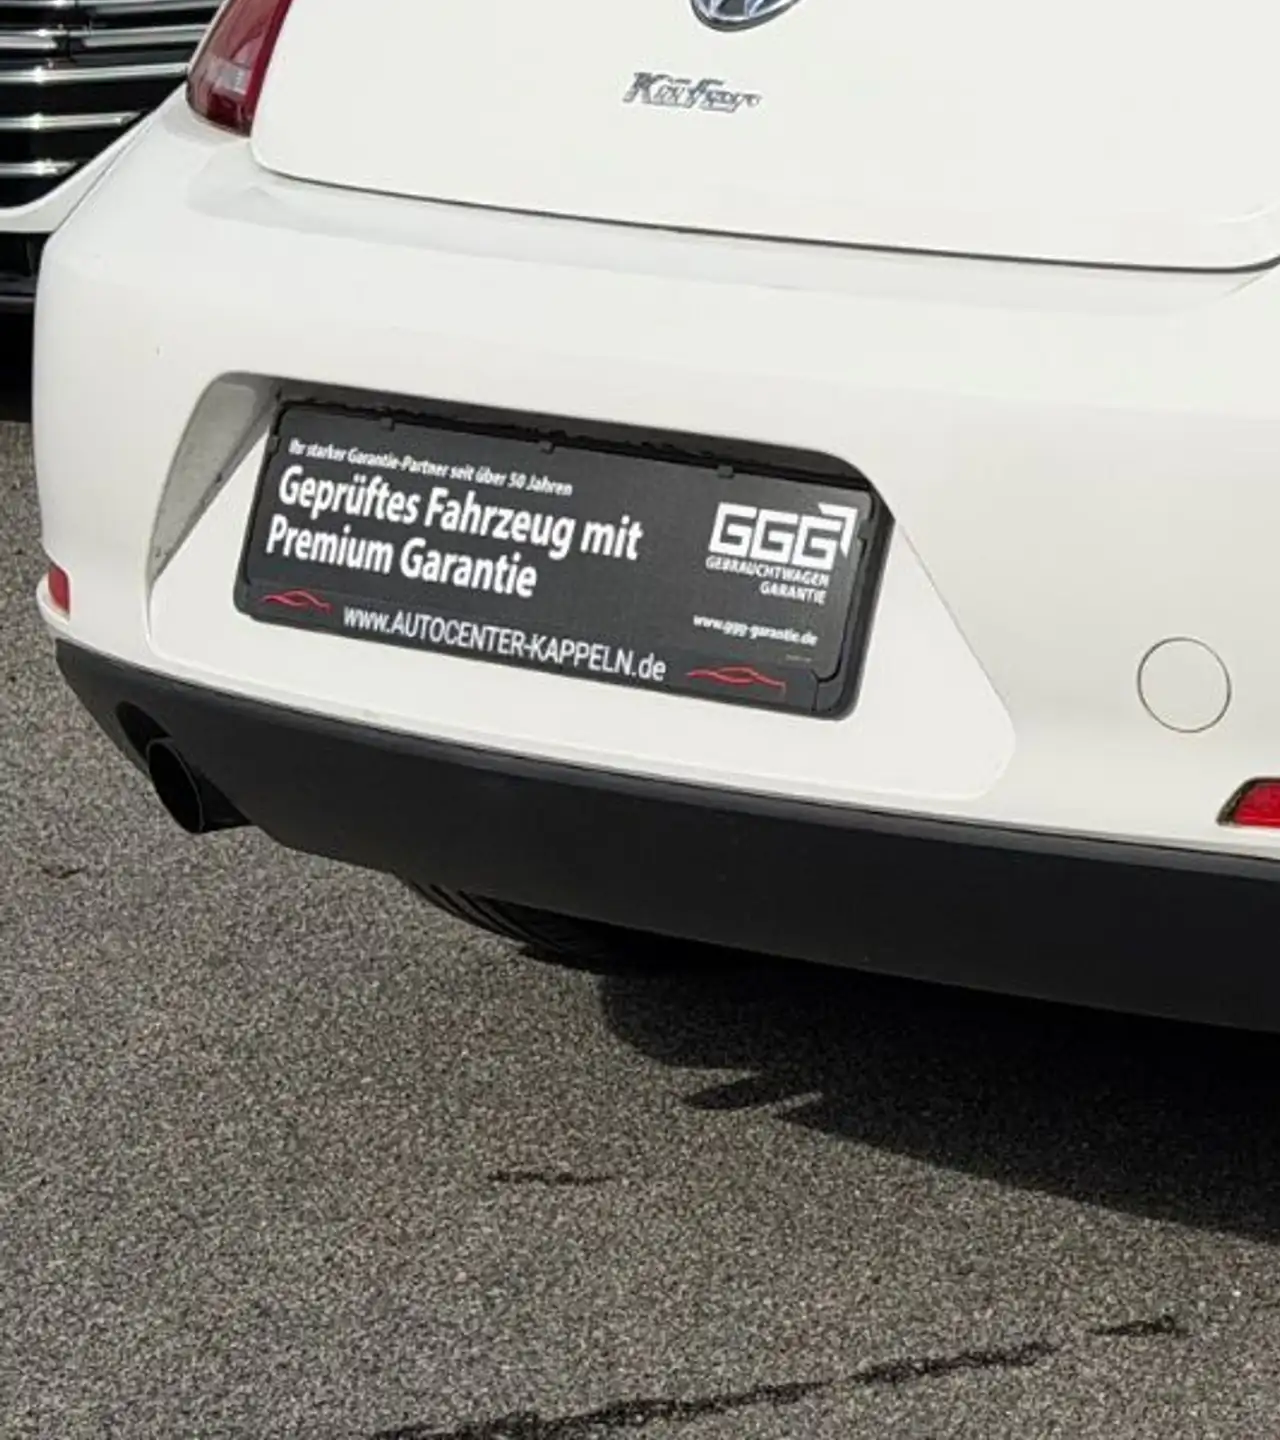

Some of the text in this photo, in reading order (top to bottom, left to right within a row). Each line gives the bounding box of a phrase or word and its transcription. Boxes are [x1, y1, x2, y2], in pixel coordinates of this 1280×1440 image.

[306, 443, 347, 463] starker
[347, 447, 449, 478] Garantie-Partner
[449, 462, 474, 483] seit
[475, 465, 507, 488] über
[508, 471, 525, 491] 50
[524, 474, 574, 497] Jahren
[279, 464, 644, 561] Geprüftes Fahrzeug mit
[707, 500, 844, 571] GGG
[266, 513, 538, 599] Premium Garantie
[705, 554, 831, 589] GEBRAUCHTWAGEN
[759, 581, 827, 606] GARANTIE
[342, 605, 667, 682] www.AUTOCENTER-KAPPELN.de
[692, 613, 819, 648] www.ggg-garantie.de
